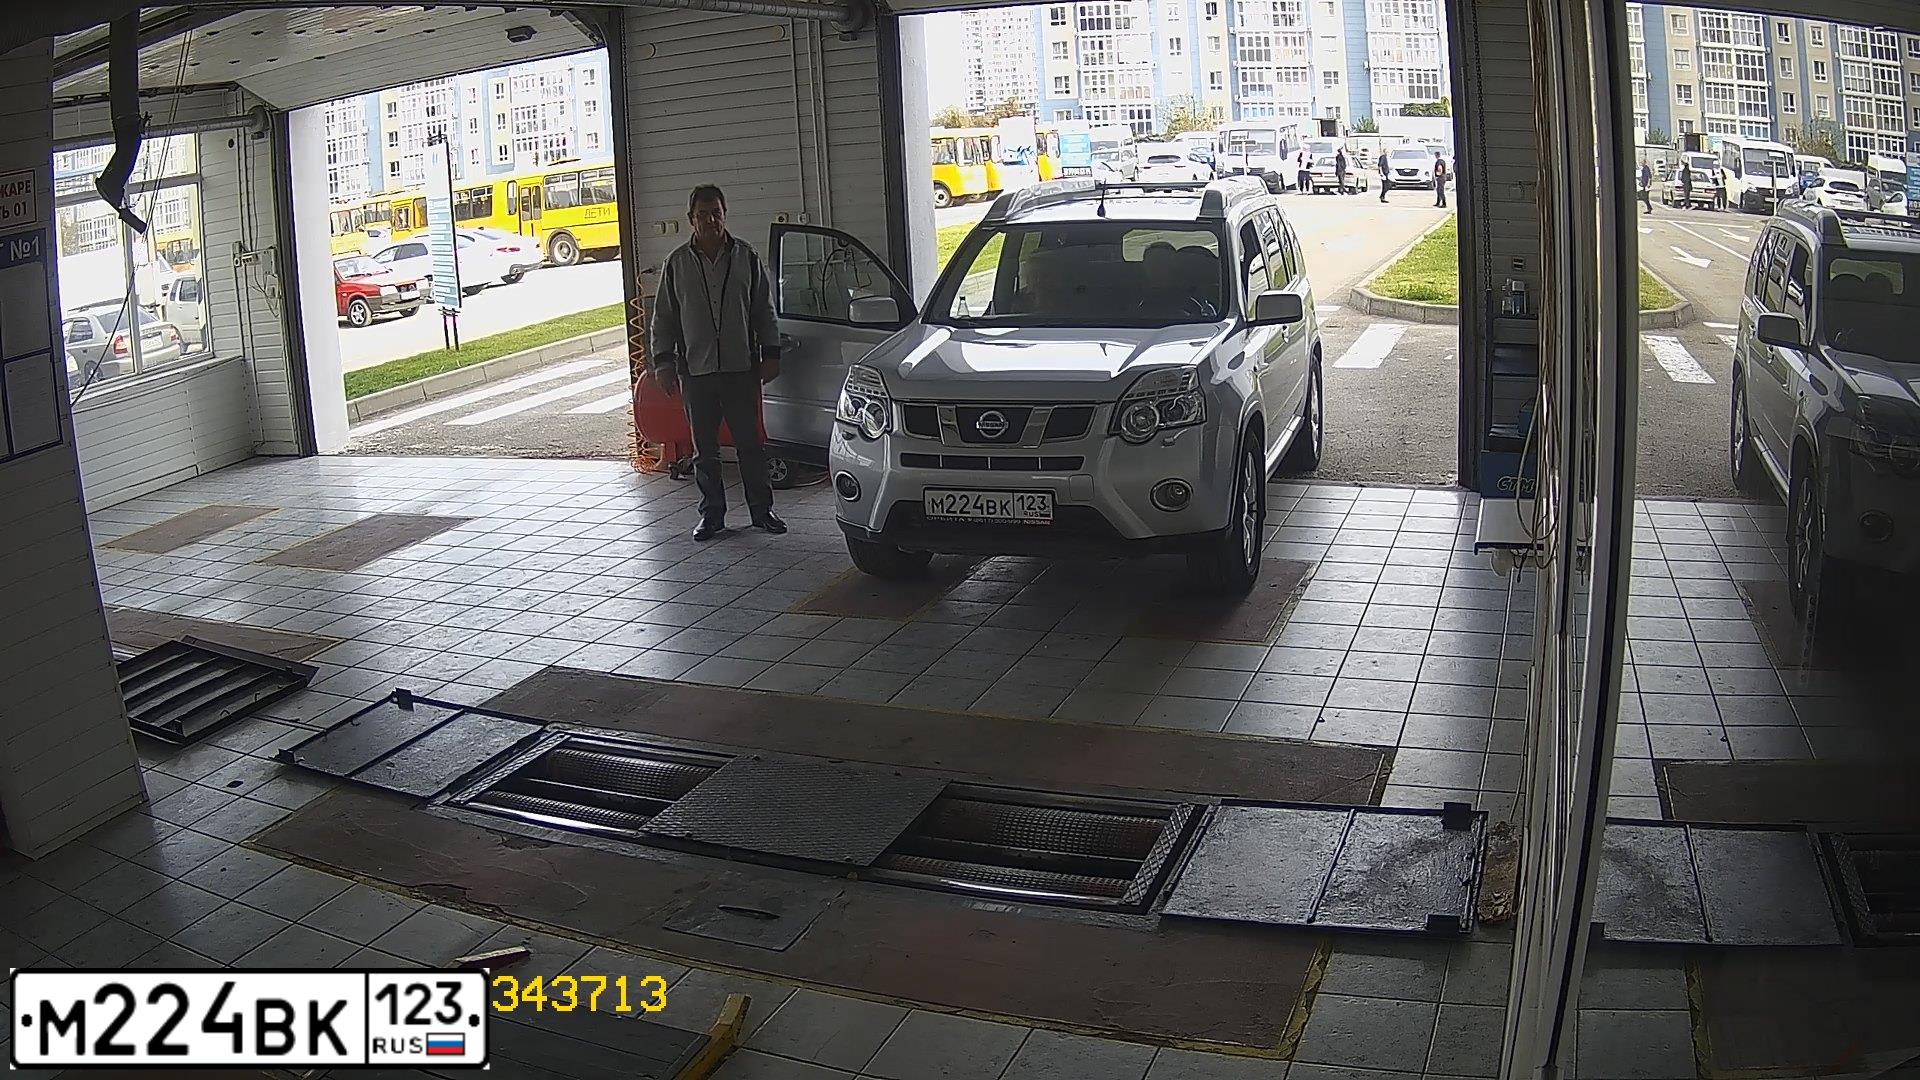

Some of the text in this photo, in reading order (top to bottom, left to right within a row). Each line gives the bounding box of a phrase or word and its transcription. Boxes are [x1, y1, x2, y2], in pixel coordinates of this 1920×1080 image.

[14, 201, 27, 216] 01
[584, 207, 611, 219] ДЕТИ
[10, 235, 39, 261] №1
[930, 494, 1047, 517] М224ВК 123
